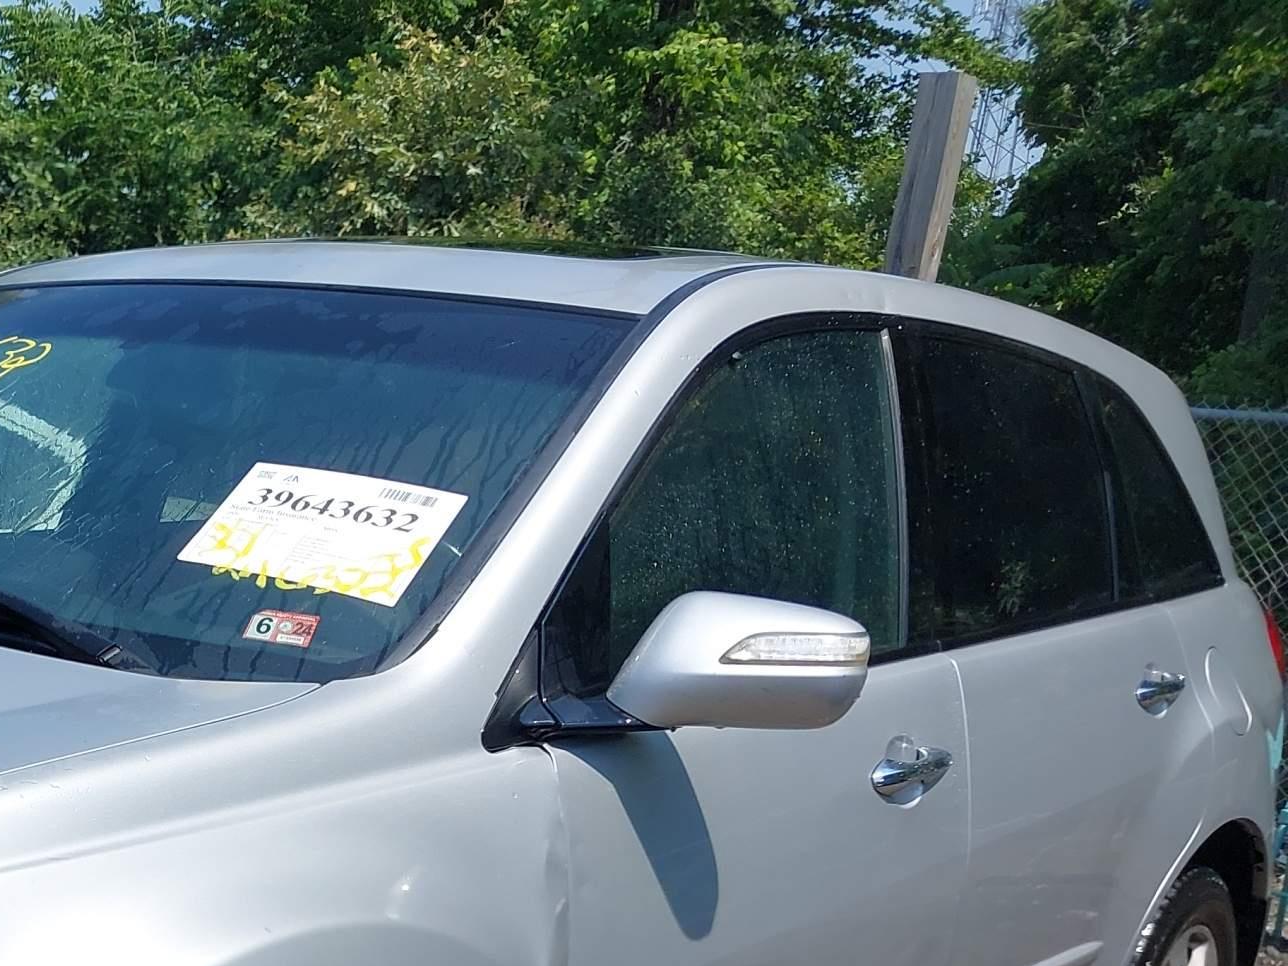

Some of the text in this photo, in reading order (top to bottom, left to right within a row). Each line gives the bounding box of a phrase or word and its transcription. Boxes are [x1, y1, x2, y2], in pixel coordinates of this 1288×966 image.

[248, 488, 419, 533] 39643632
[255, 617, 274, 634] 6
[292, 622, 314, 636] 24
